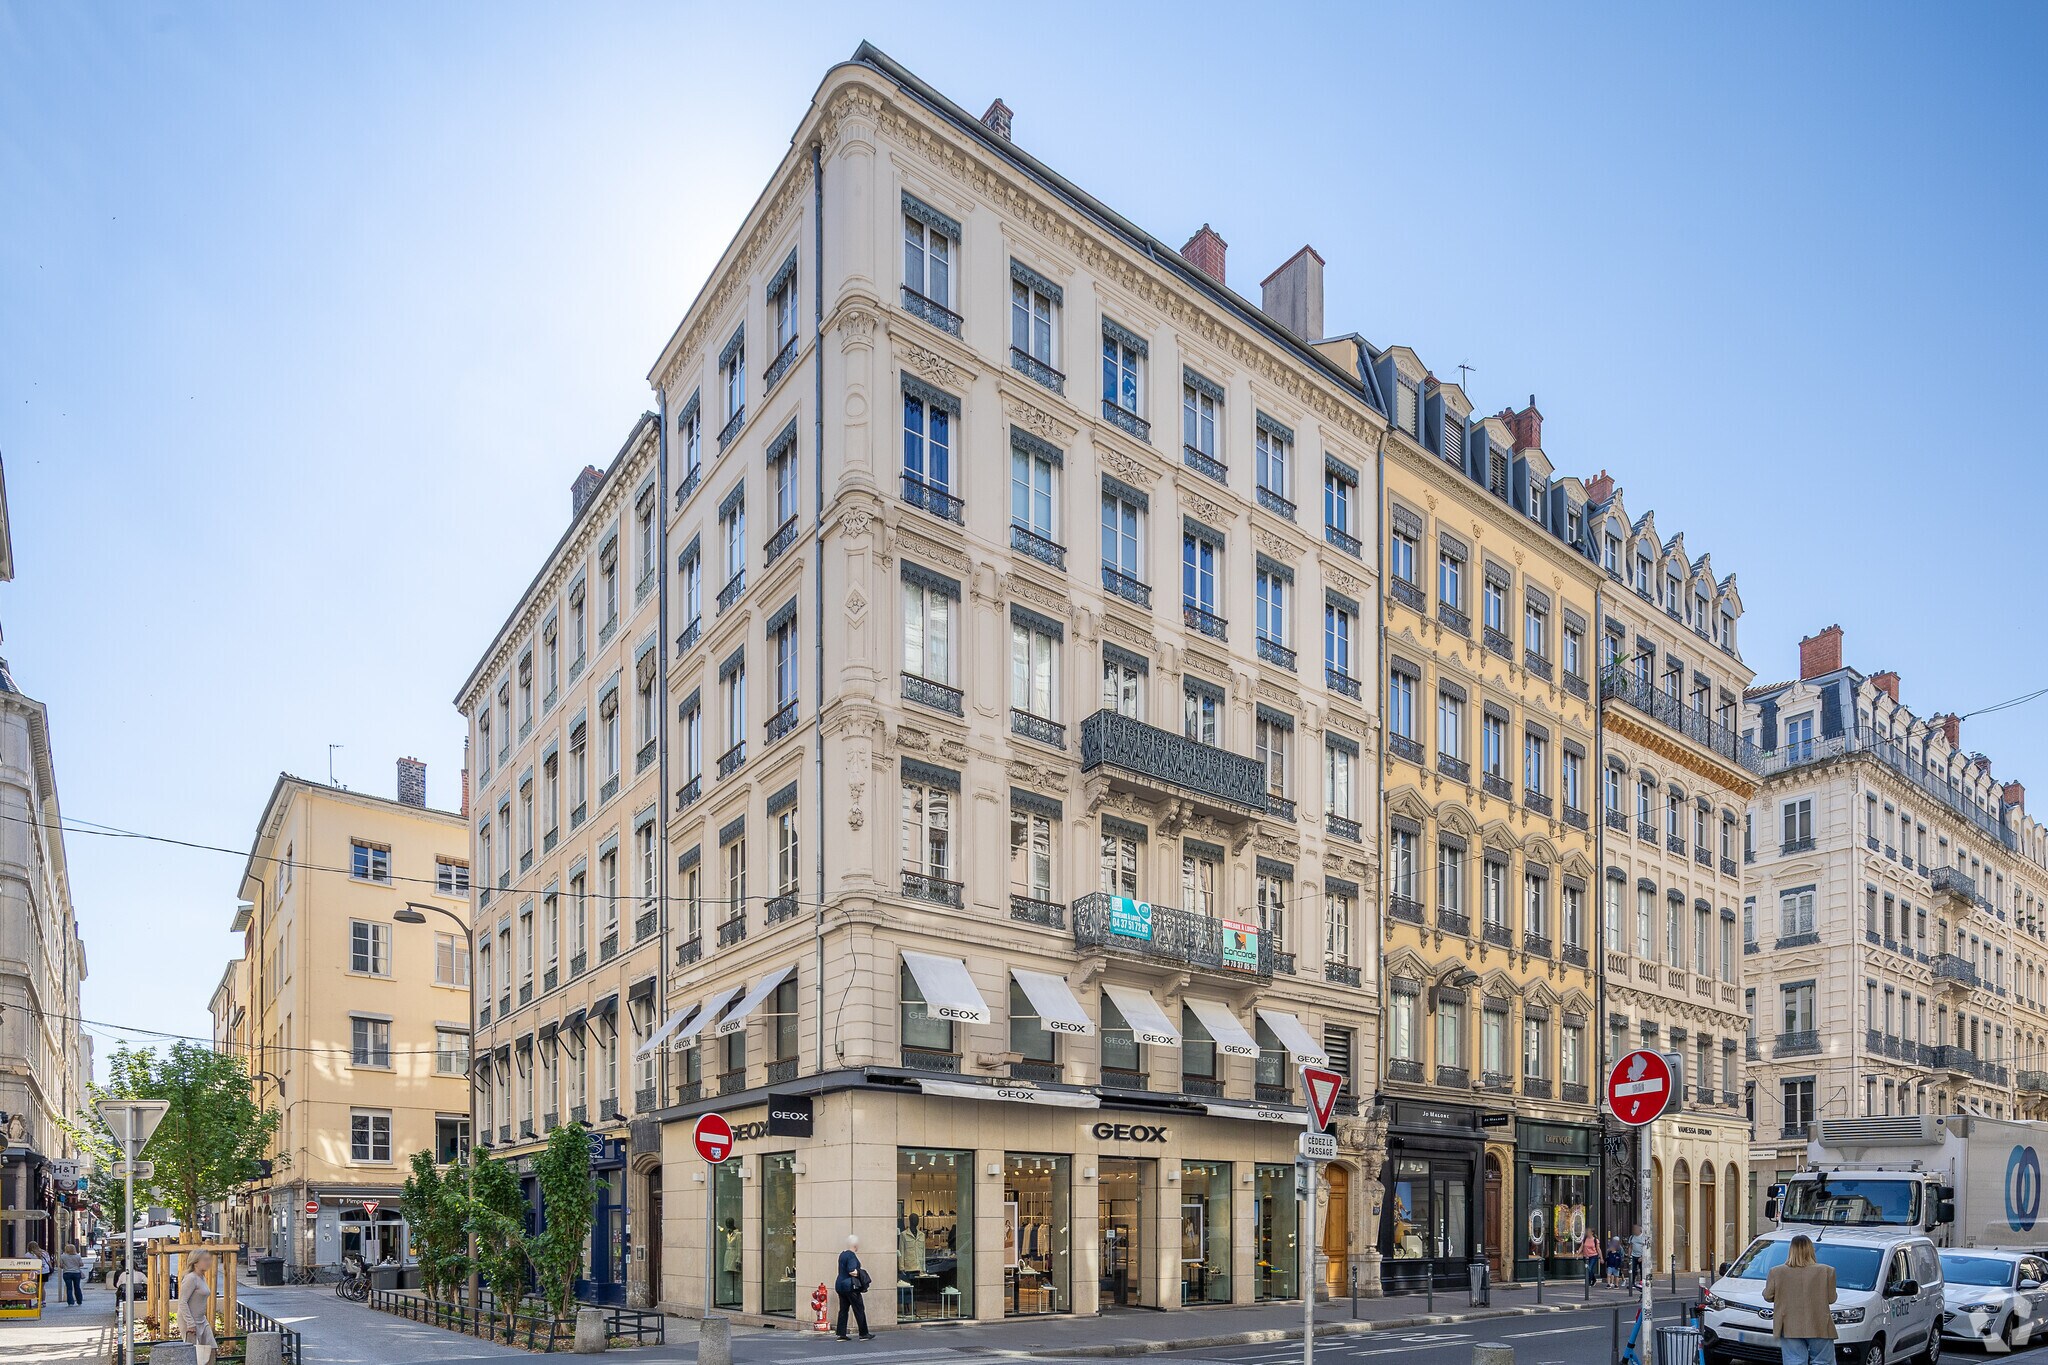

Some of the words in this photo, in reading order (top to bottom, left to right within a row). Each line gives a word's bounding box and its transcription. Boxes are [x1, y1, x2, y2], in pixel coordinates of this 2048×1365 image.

[1112, 918, 1120, 927] 04
[1121, 919, 1127, 928] 37
[1128, 920, 1134, 930] 51
[1135, 922, 1141, 932] 72
[1224, 946, 1256, 959] Concorde
[939, 1008, 980, 1020] GEOX
[720, 1021, 741, 1033] GEOX
[783, 1024, 798, 1034] GEO
[1051, 1021, 1085, 1033] GEOX
[1104, 1036, 1132, 1046] GEOX
[1142, 1033, 1173, 1044] GEOX
[674, 1039, 691, 1050] GEOX
[1224, 1045, 1252, 1055] GEOX
[636, 1051, 650, 1062] GEOX
[1297, 1055, 1322, 1064] GEOX
[997, 1089, 1034, 1100] GEOX
[772, 1111, 808, 1121] GEOX
[1258, 1111, 1284, 1120] GEOX
[1092, 1123, 1167, 1143] GEOX
[1678, 1126, 1696, 1134] VANESSA
[1308, 1136, 1326, 1146] CÉDEZ
[1308, 1147, 1333, 1156] PASSAGE
